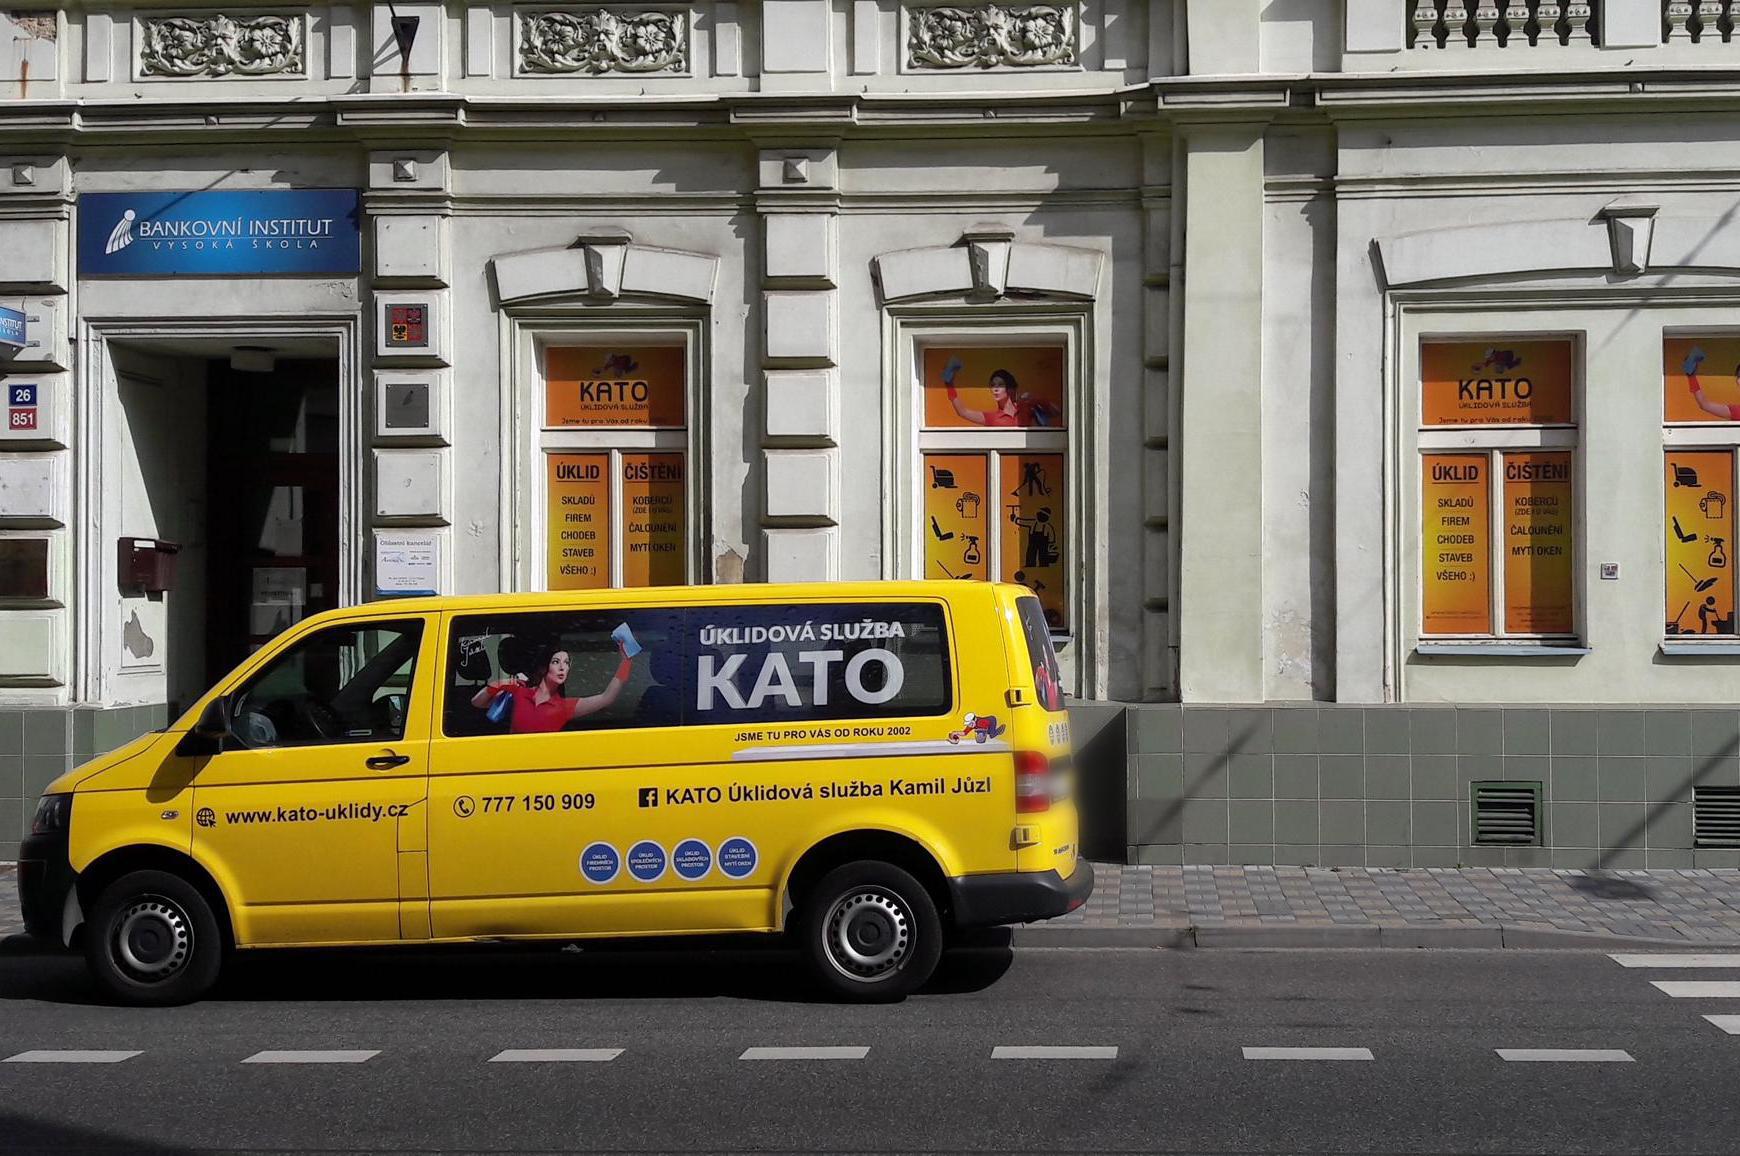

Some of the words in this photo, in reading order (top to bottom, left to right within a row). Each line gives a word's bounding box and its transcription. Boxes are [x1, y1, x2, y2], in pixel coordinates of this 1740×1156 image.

[140, 217, 243, 236] BANKOVNÍ
[250, 219, 332, 236] INSTITUT
[153, 239, 233, 249] VYSOKÁ
[253, 238, 318, 249] ŠKOLA
[16, 389, 31, 402] 26
[580, 381, 648, 402] KATO
[1459, 378, 1532, 400] KATO
[12, 412, 33, 426] 851
[556, 462, 600, 479] ÚKLID
[1432, 462, 1478, 480] ÚKLID
[1506, 461, 1569, 480] ČIŠTĚNÍ
[565, 513, 592, 522] FIREM
[1441, 516, 1470, 526] FIREM
[561, 531, 596, 540] CHODEB
[1437, 535, 1475, 545] CHODEB
[562, 548, 594, 558] STAVEB
[1438, 553, 1473, 563] STAVEB
[1537, 546, 1562, 555] OKEN
[560, 564, 589, 575] VŠEHO
[1436, 569, 1467, 581] VŠEHO
[700, 620, 815, 645] ÚKLIDOVÁ
[820, 619, 905, 640] SLUŽBA
[697, 648, 904, 711] KATO
[735, 731, 764, 742] JSME
[767, 731, 781, 740] TU
[784, 730, 807, 740] PRO
[809, 728, 831, 739] VÁS
[834, 728, 850, 738] OD
[853, 727, 884, 737] ROKU
[887, 726, 911, 736] 2002
[666, 787, 722, 805] KATO
[728, 781, 814, 803] Úklidová
[819, 780, 884, 801] služba
[889, 777, 945, 796] Kamil
[951, 776, 992, 795] Jůzl
[482, 796, 515, 813] 777
[522, 795, 555, 811] 150
[561, 793, 596, 810] 909
[226, 802, 409, 824] www.kato-uklidy.cz
